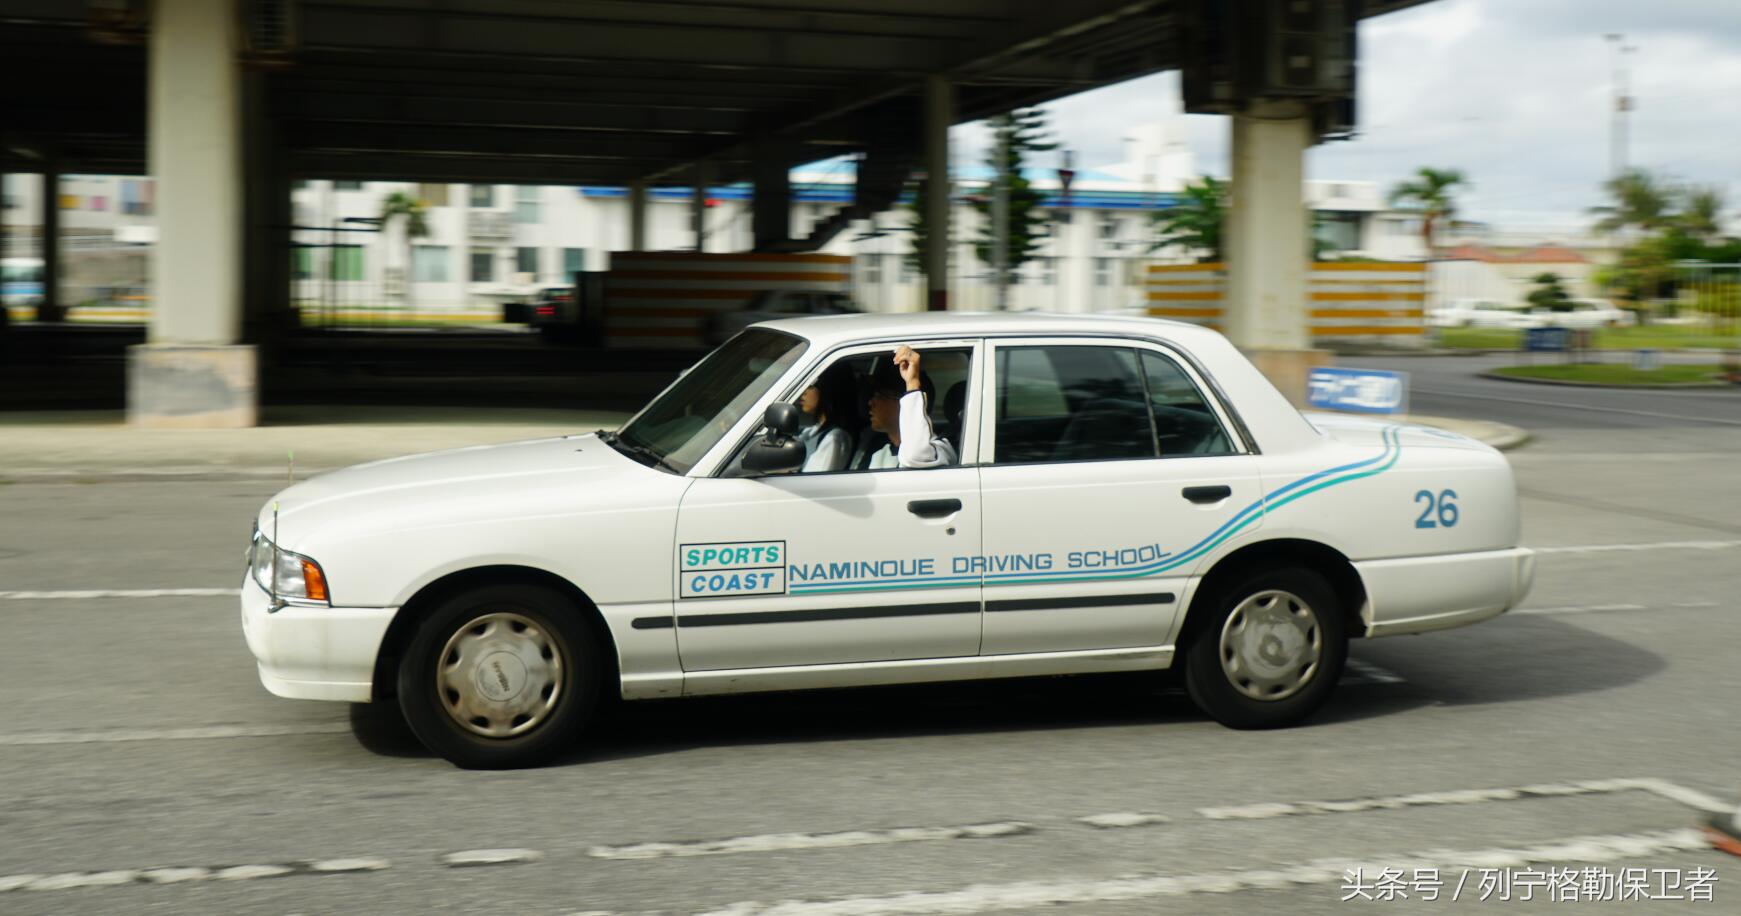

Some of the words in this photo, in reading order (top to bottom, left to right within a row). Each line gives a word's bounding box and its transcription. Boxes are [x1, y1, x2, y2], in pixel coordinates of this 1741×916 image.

[1414, 489, 1459, 529] 26
[686, 546, 780, 567] SPORTS
[789, 558, 935, 581] NAMINOUE
[952, 554, 1053, 574] DRIVING
[1067, 543, 1171, 568] SCHOOL
[690, 572, 775, 592] COAST
